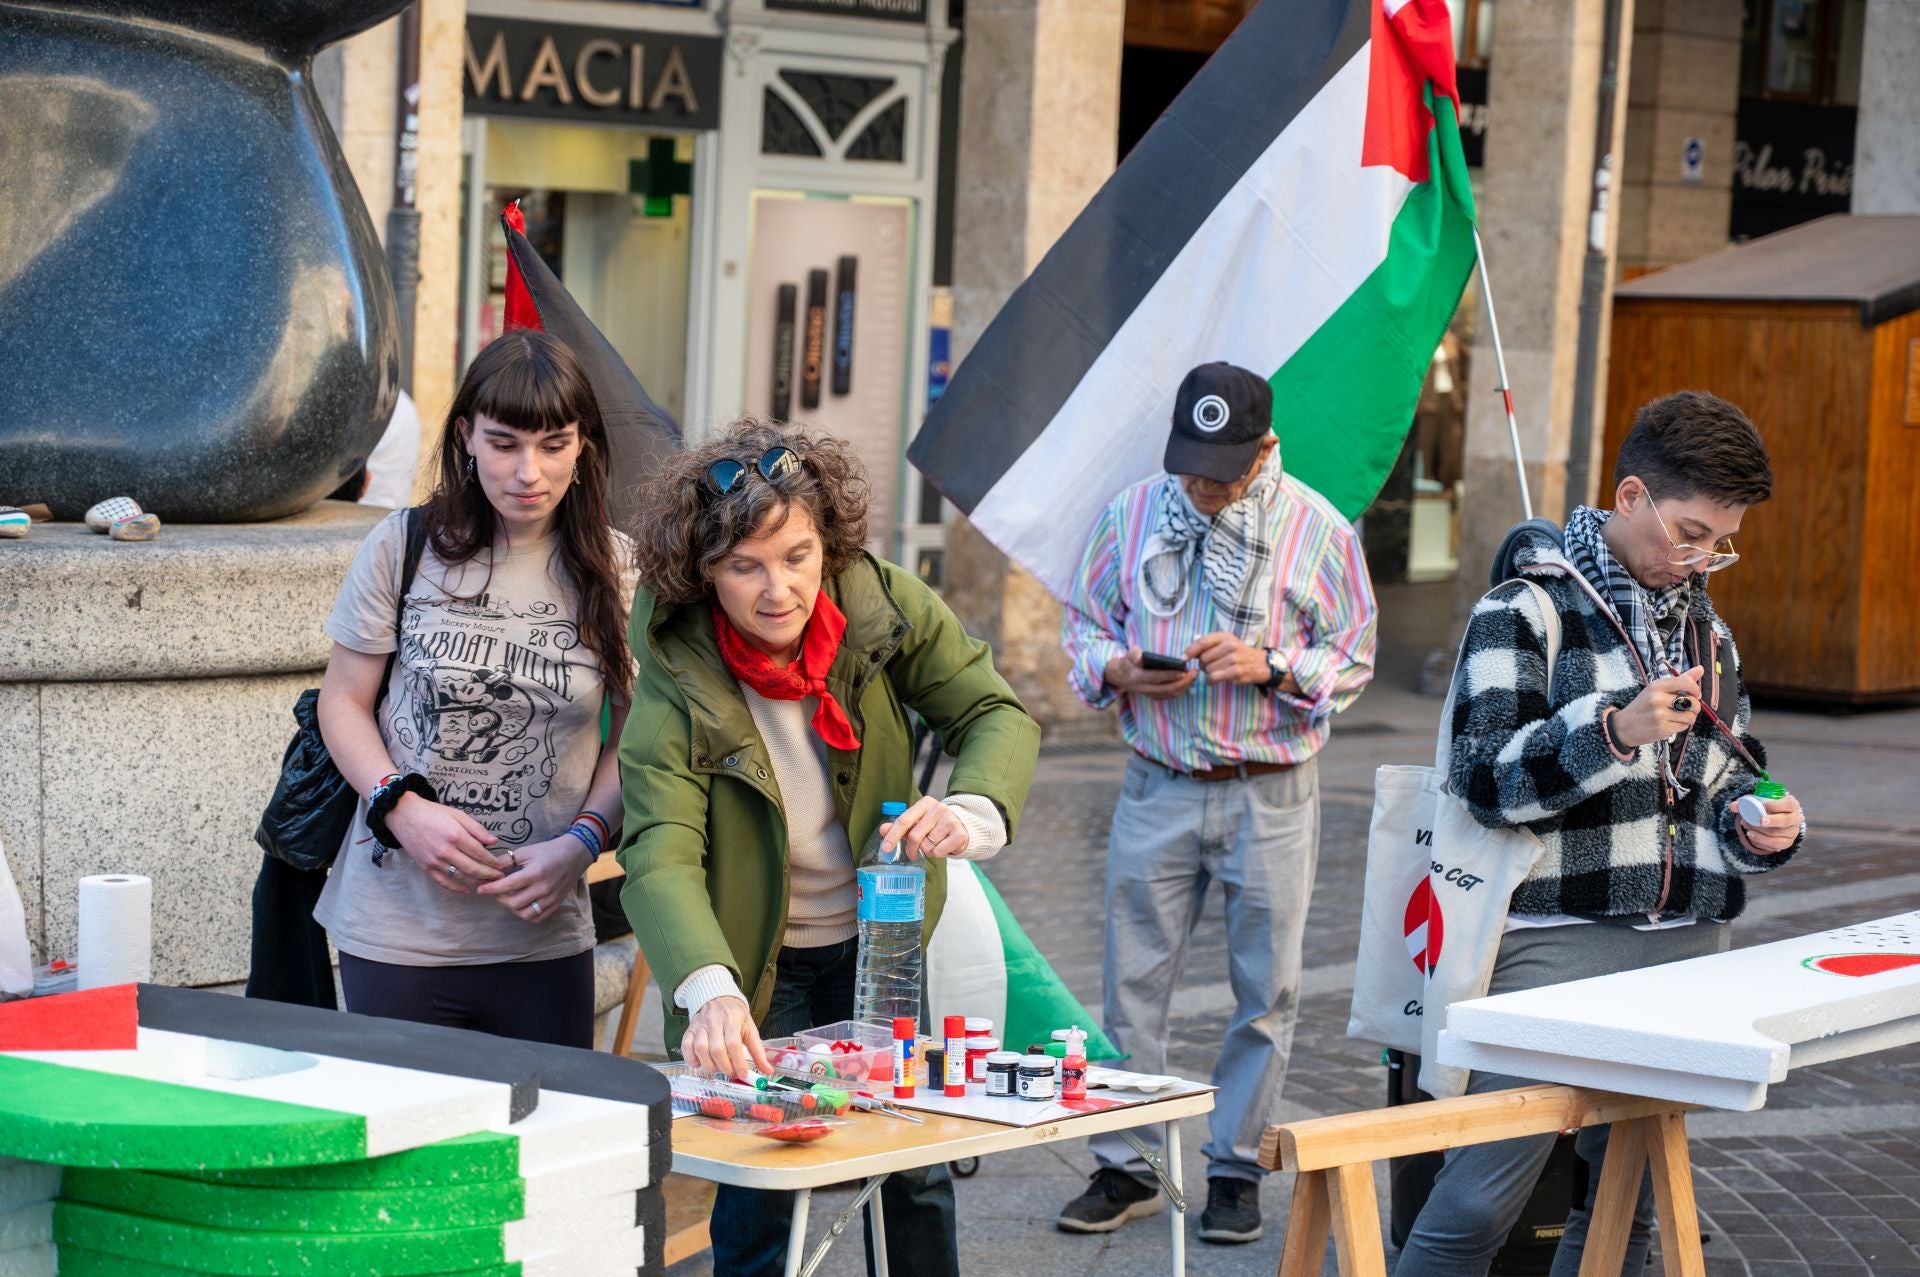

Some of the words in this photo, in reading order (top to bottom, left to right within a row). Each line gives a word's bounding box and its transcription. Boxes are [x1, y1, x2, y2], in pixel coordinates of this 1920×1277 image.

[464, 31, 698, 113] MACIA
[528, 628, 548, 648] 28
[505, 641, 574, 703] WILLIE
[435, 765, 489, 776] CARTOONS
[444, 779, 522, 812] MOUSE
[1445, 868, 1484, 891] CGT
